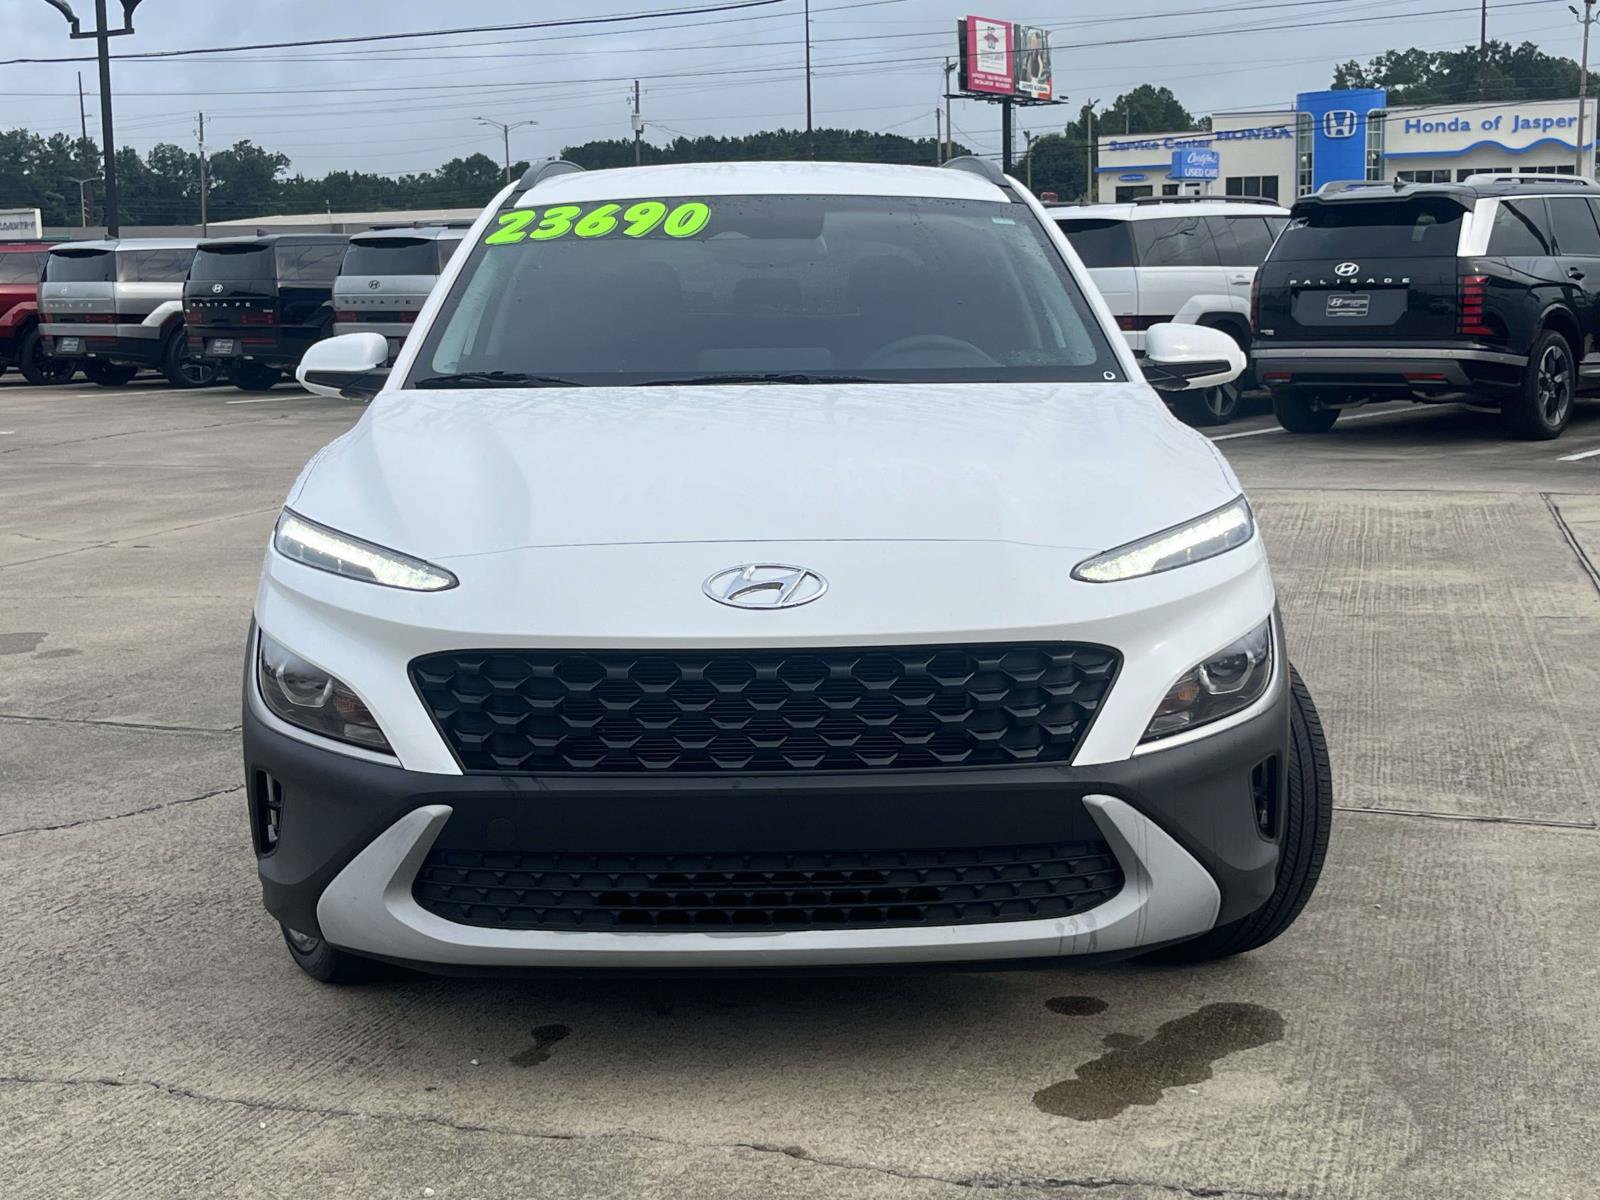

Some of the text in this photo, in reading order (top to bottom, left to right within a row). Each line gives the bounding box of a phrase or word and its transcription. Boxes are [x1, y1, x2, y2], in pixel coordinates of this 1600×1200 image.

[1404, 115, 1577, 134] Honda of Jasper
[1216, 126, 1293, 141] HONDA
[1109, 137, 1212, 151] Service Center
[1184, 168, 1204, 177] USED
[484, 200, 712, 246] 23690
[1289, 277, 1412, 286] PALISADE
